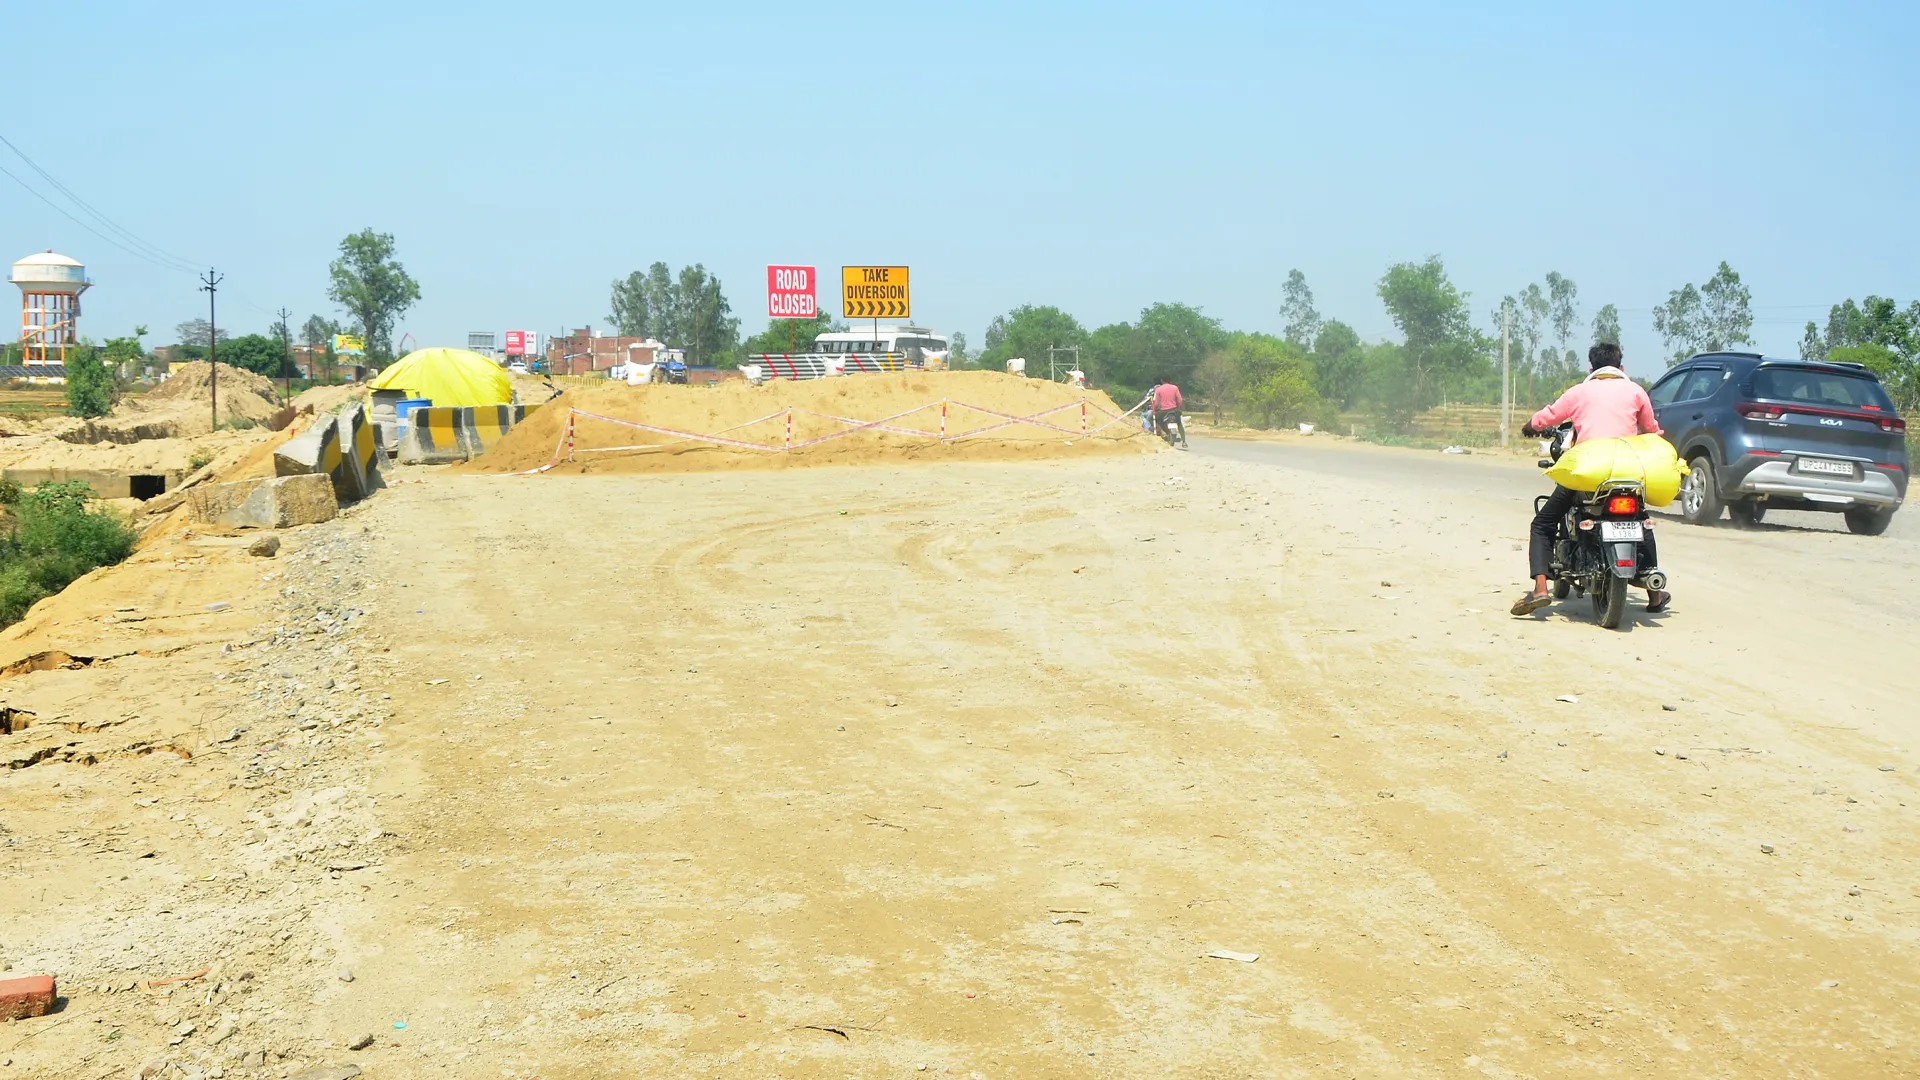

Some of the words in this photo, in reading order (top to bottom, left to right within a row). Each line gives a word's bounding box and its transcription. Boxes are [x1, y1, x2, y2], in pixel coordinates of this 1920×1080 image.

[776, 269, 807, 290] ROAD
[862, 268, 889, 282] TAKE
[847, 285, 905, 299] DIVERSION
[770, 293, 814, 315] CLOSED
